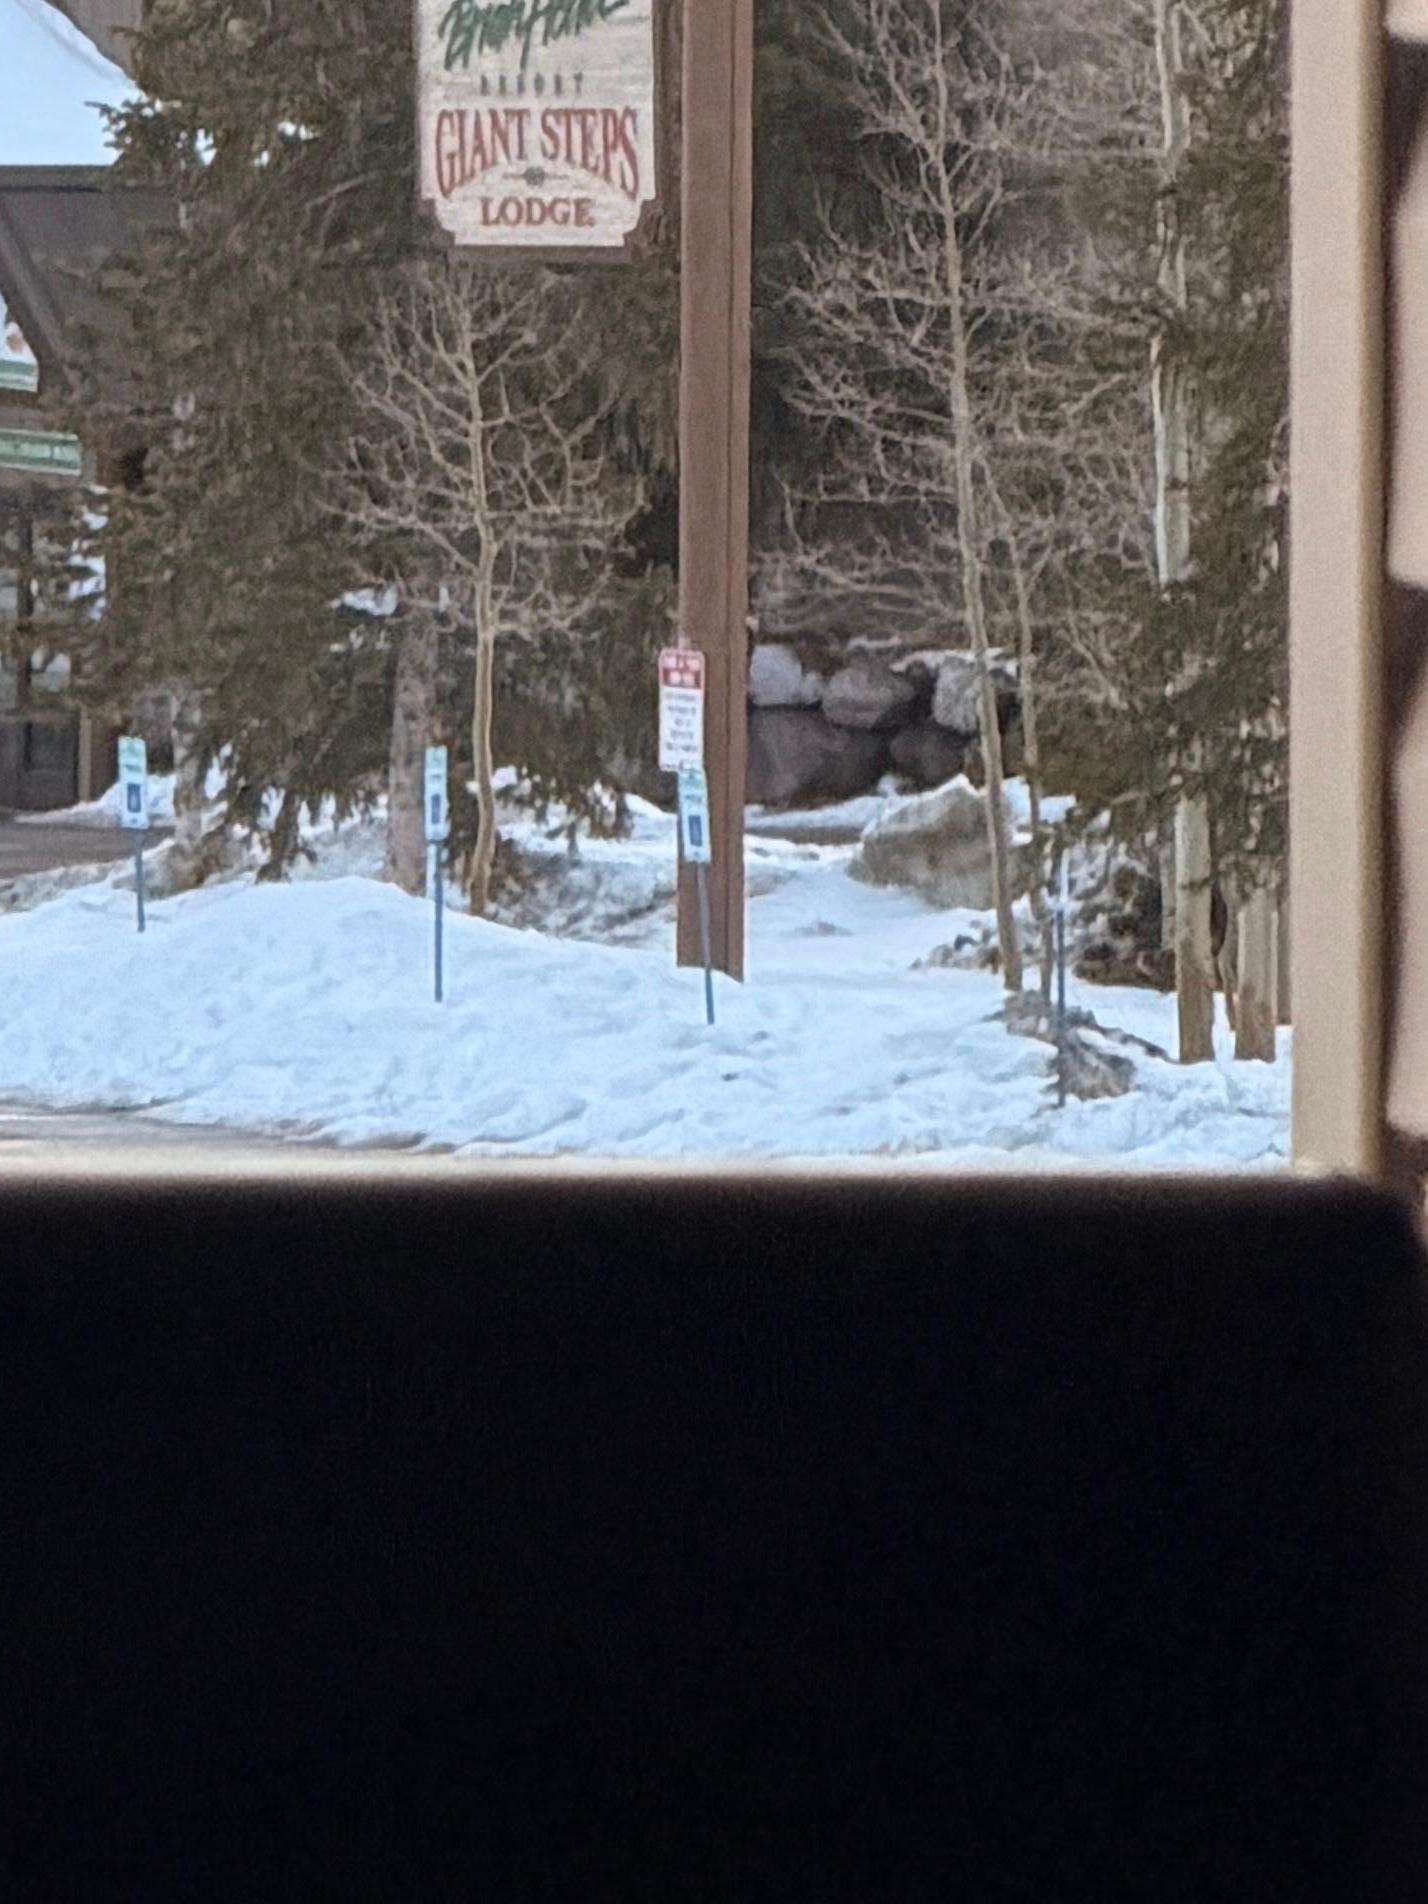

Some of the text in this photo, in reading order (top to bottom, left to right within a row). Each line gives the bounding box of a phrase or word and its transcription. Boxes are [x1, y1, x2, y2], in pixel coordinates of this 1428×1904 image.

[435, 106, 640, 202] GIANT STEPS
[480, 195, 596, 228] LODGE
